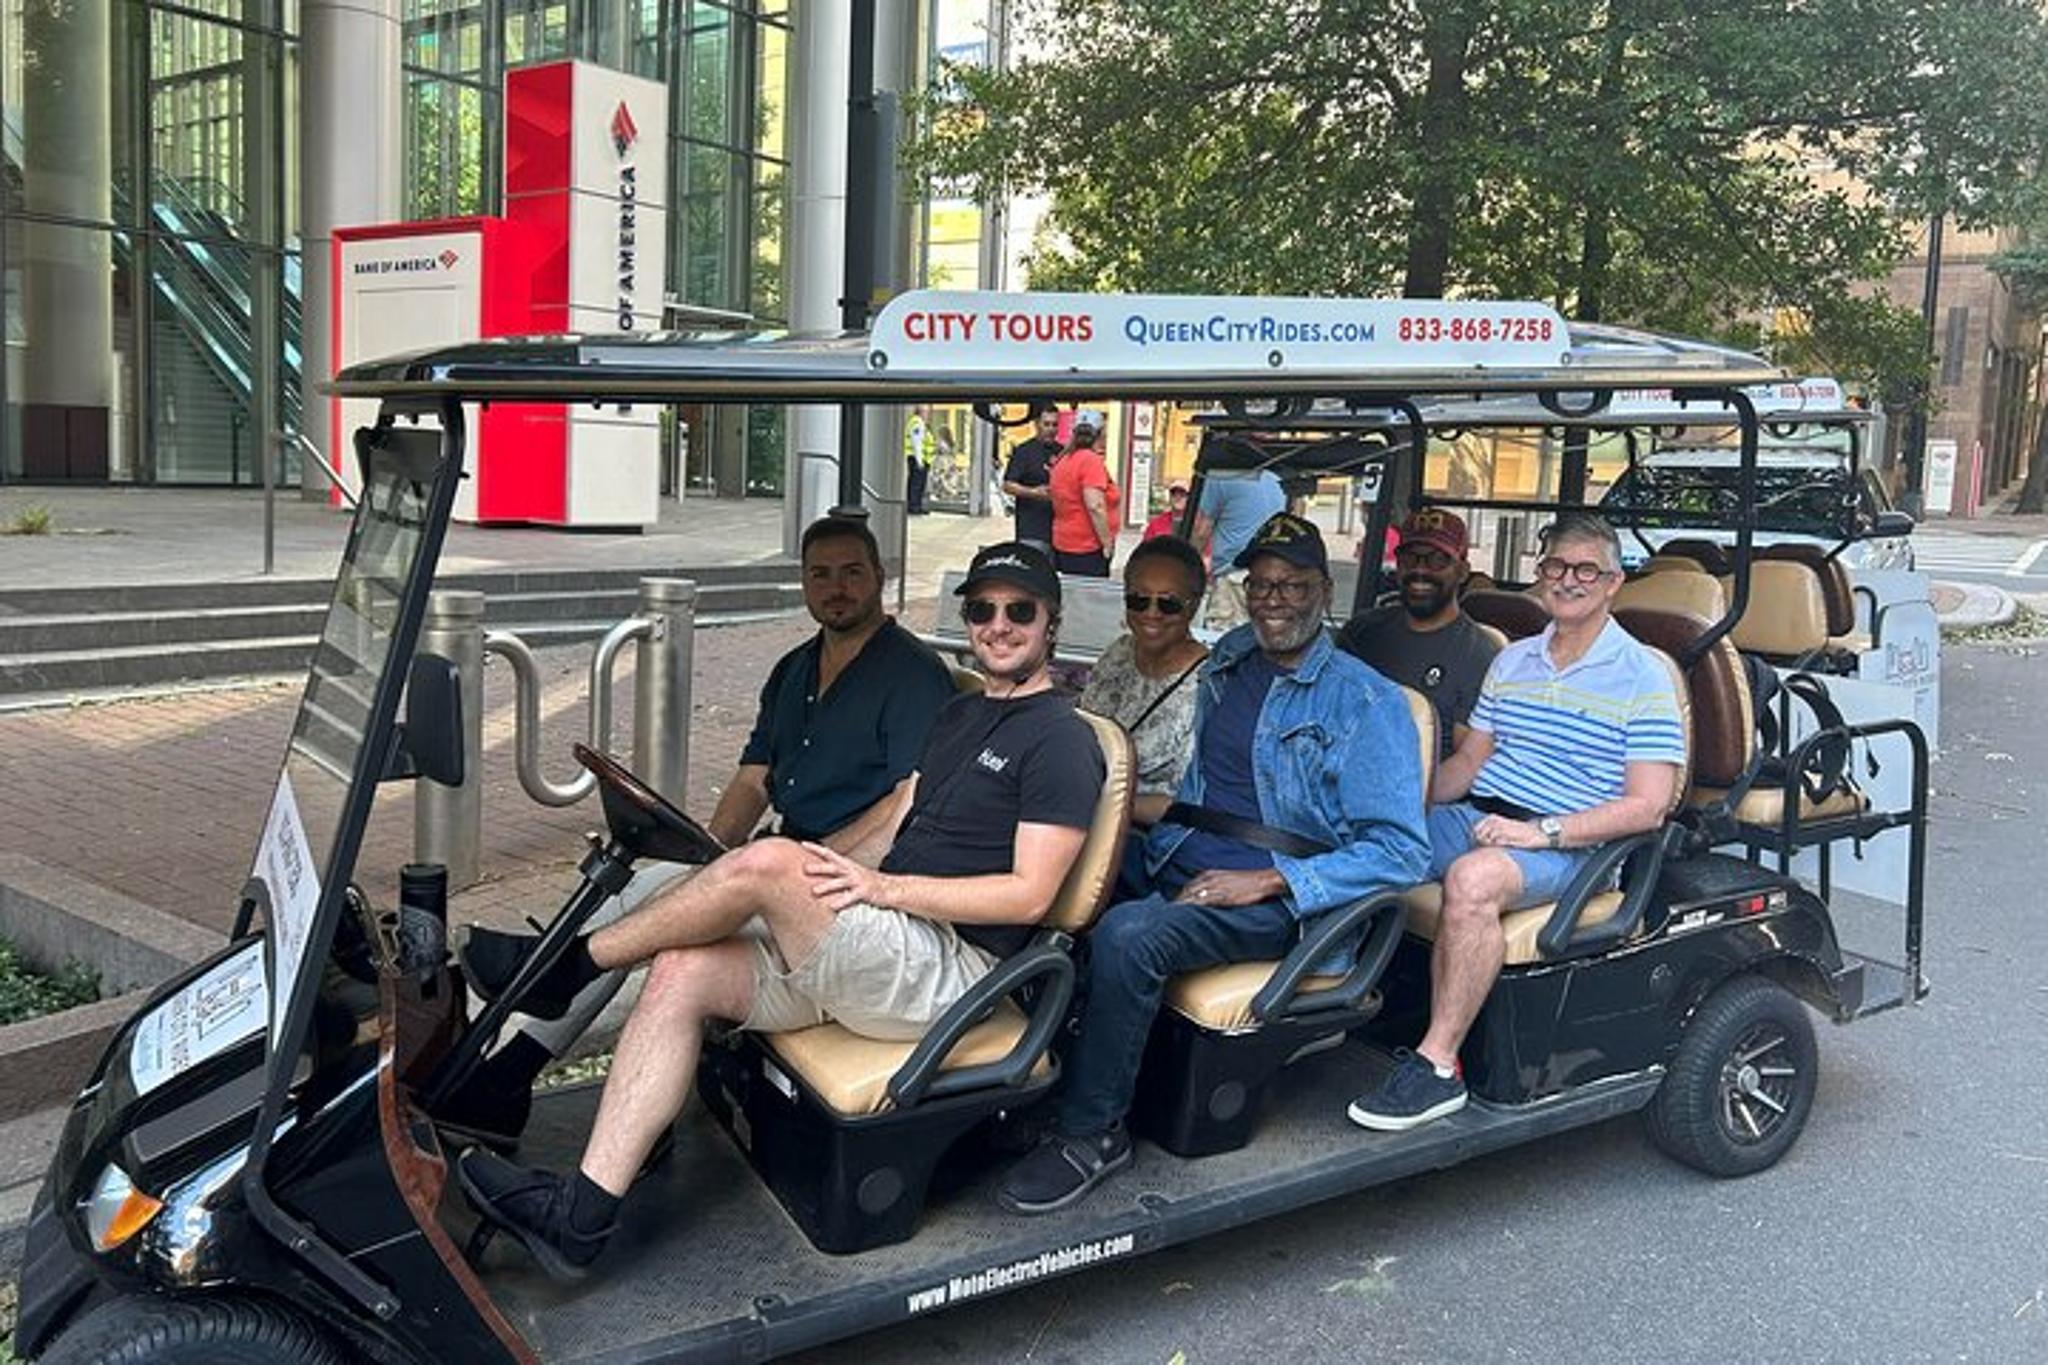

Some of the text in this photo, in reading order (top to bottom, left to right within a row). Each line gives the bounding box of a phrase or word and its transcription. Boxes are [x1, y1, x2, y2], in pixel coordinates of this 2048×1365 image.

[618, 165, 636, 331] OF AMERICA
[903, 312, 977, 342] CITY
[988, 314, 1093, 342] TOURS
[1398, 317, 1552, 343] 833-868-7258
